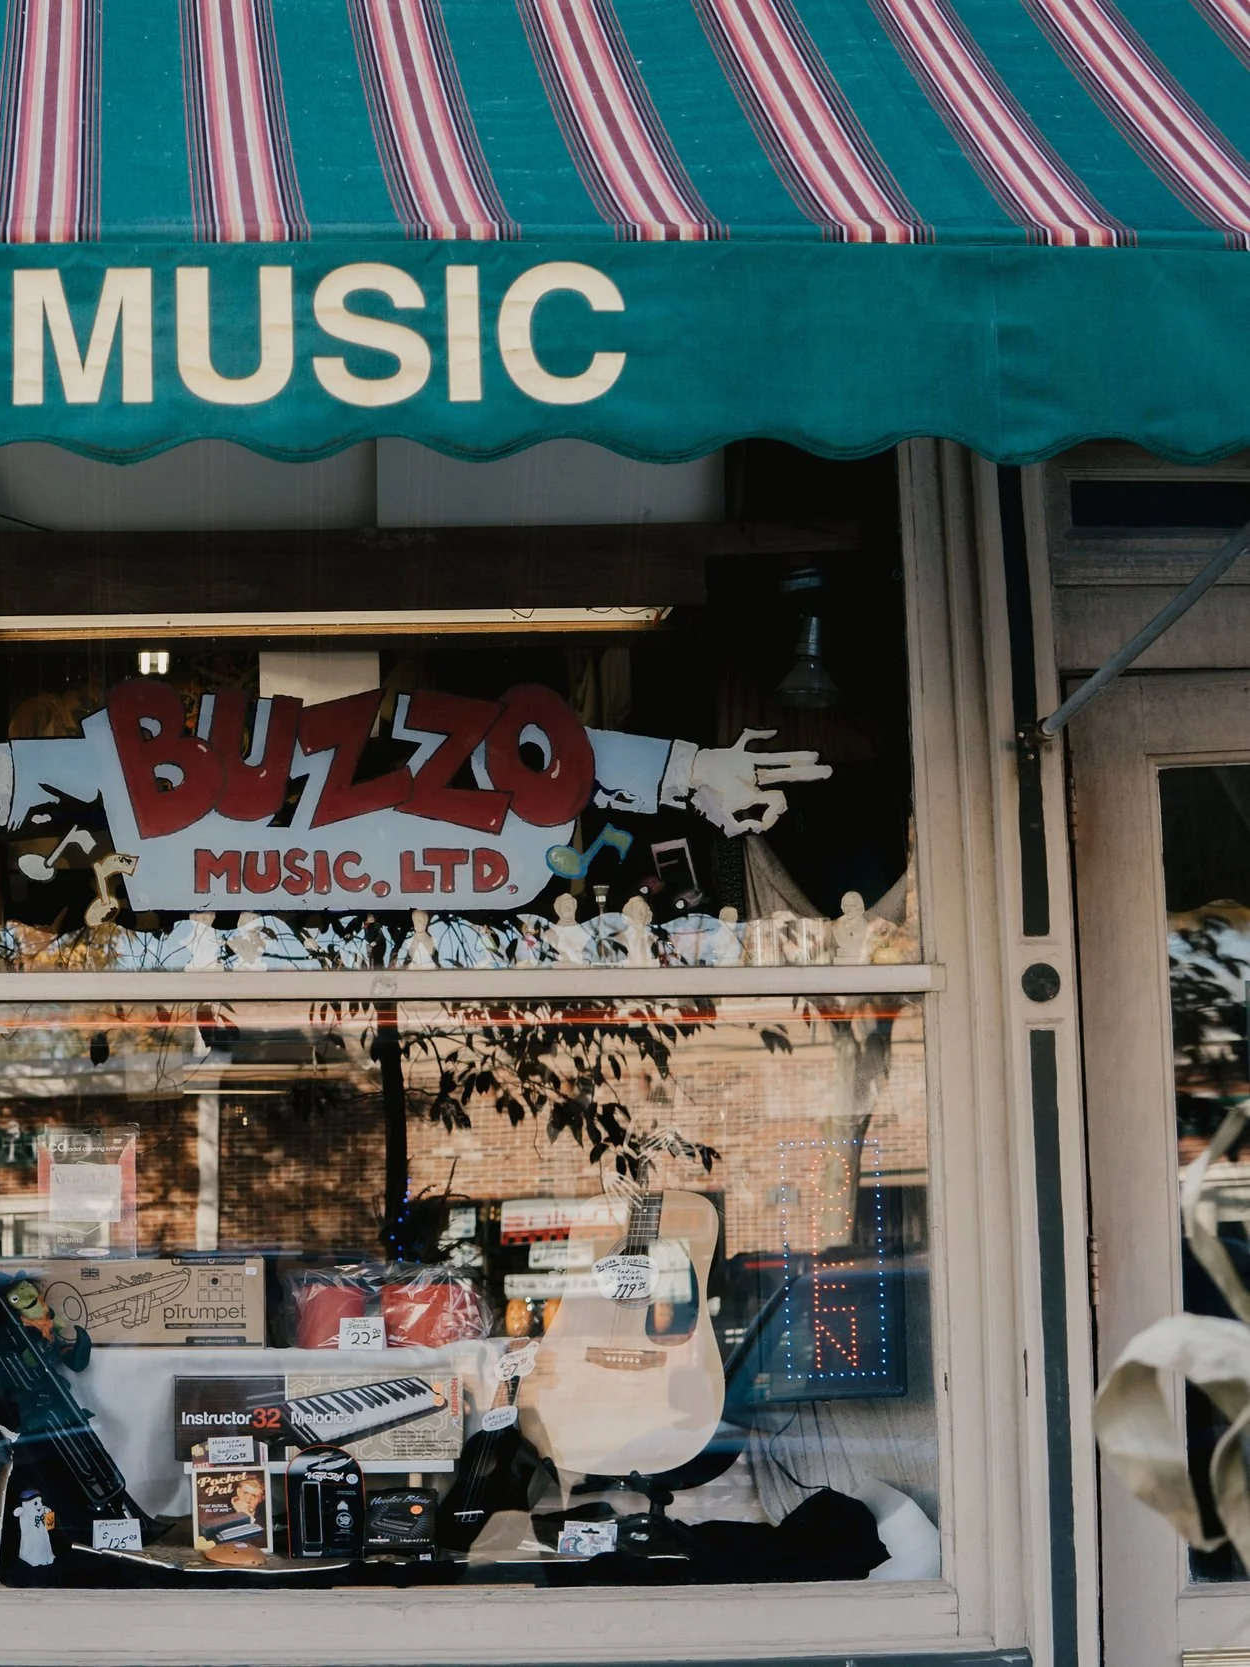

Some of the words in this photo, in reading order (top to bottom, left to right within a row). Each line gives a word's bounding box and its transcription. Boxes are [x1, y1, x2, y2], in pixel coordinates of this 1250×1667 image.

[11, 262, 626, 408] MUSIC
[106, 680, 596, 839] BUZZO
[399, 847, 519, 895] LTD.
[810, 1150, 857, 1368] OPEN
[181, 1410, 252, 1425] Instructor
[252, 1407, 282, 1429] 32
[290, 1411, 353, 1425] Melodica
[197, 1472, 248, 1487] Pocket
[205, 1484, 234, 1496] Pal
